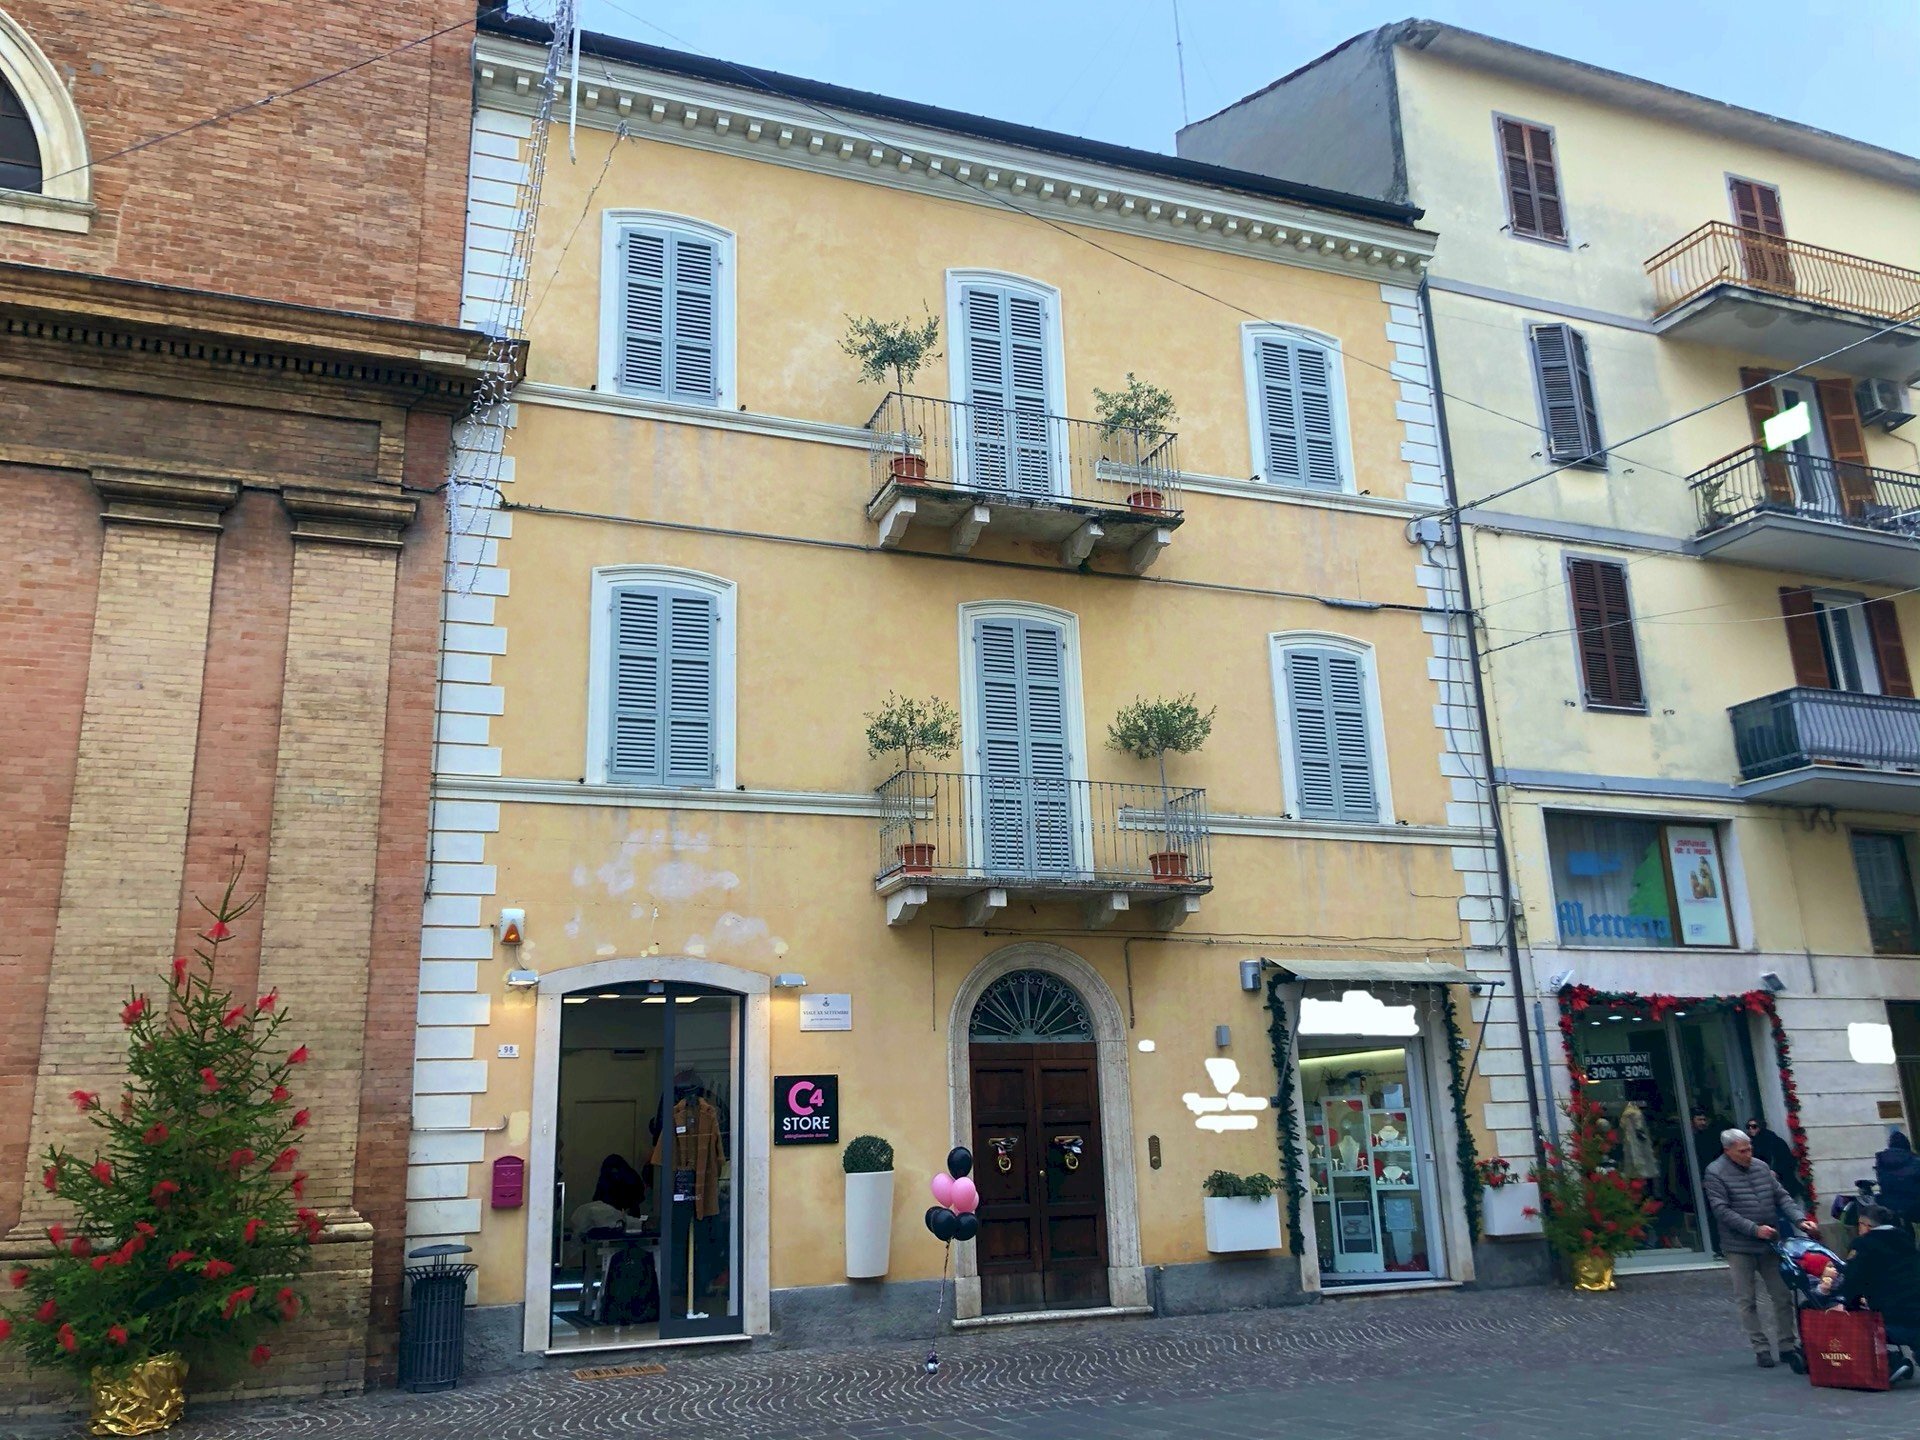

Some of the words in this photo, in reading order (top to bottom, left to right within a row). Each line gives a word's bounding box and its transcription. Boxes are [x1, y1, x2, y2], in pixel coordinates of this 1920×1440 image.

[1585, 1056, 1615, 1065] BLACK
[1616, 1054, 1647, 1063] FRIDAY
[1589, 1067, 1617, 1078] -30%
[1621, 1065, 1650, 1077] -50%
[788, 1081, 824, 1115] C4
[783, 1116, 830, 1130] STORE
